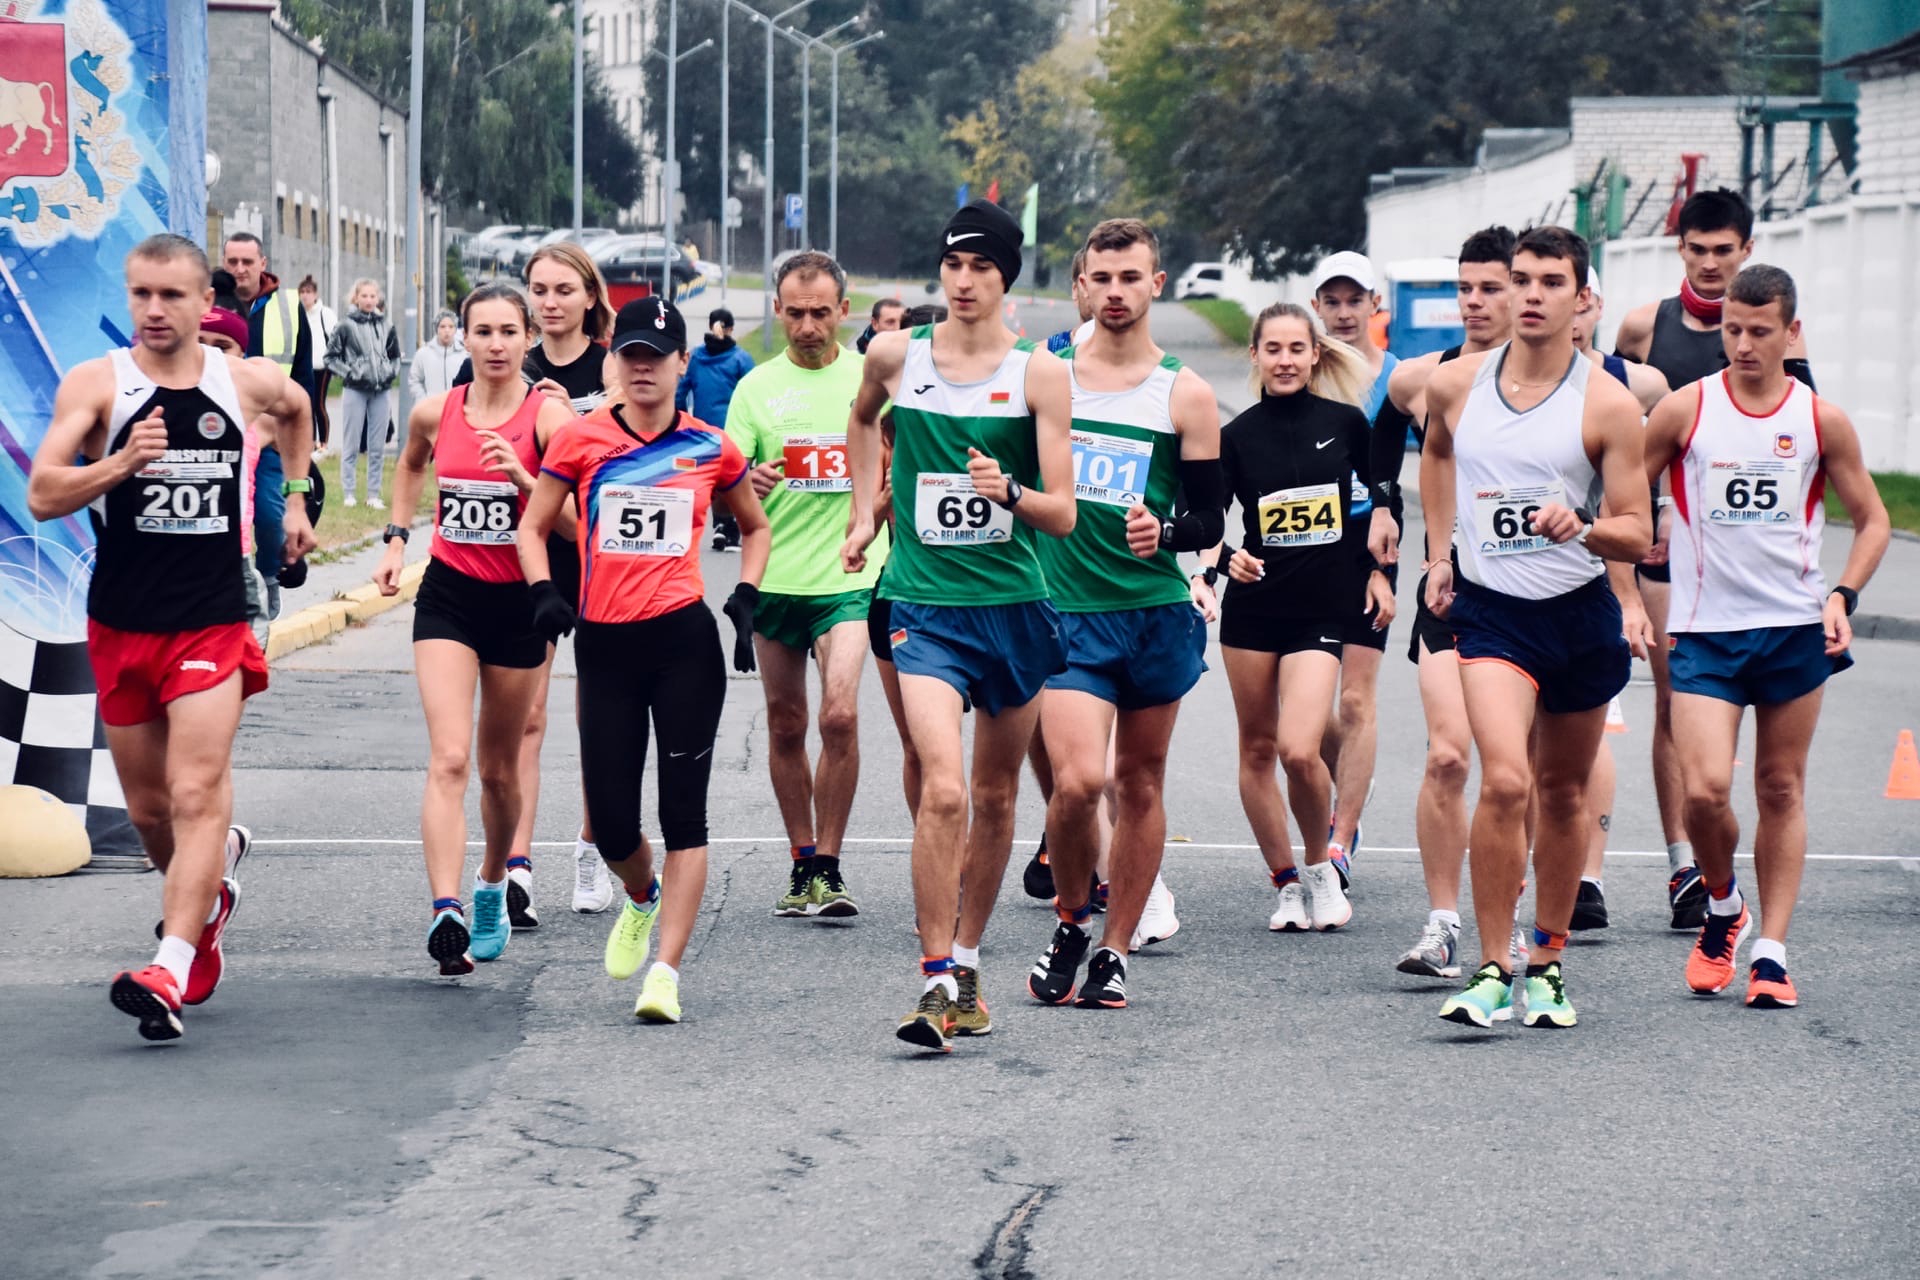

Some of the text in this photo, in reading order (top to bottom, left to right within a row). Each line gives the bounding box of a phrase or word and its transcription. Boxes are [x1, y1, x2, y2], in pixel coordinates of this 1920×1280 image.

[791, 196, 803, 216] P
[802, 450, 847, 478] 13
[1072, 451, 1137, 492] 101
[805, 479, 834, 489] BELARUS
[1076, 484, 1108, 497] BELARUS
[1726, 478, 1778, 510] 65
[142, 484, 221, 518] 201
[442, 498, 512, 531] 208
[937, 496, 992, 529] 69
[1266, 502, 1335, 534] 254
[1728, 510, 1762, 521] BELARUS
[618, 508, 667, 540] 51
[455, 530, 484, 540] BELARUS
[622, 539, 654, 550] BELARUS
[941, 529, 976, 541] BELARUS
[1283, 532, 1312, 544] BELARUS
[1498, 537, 1533, 552] BELARUS
